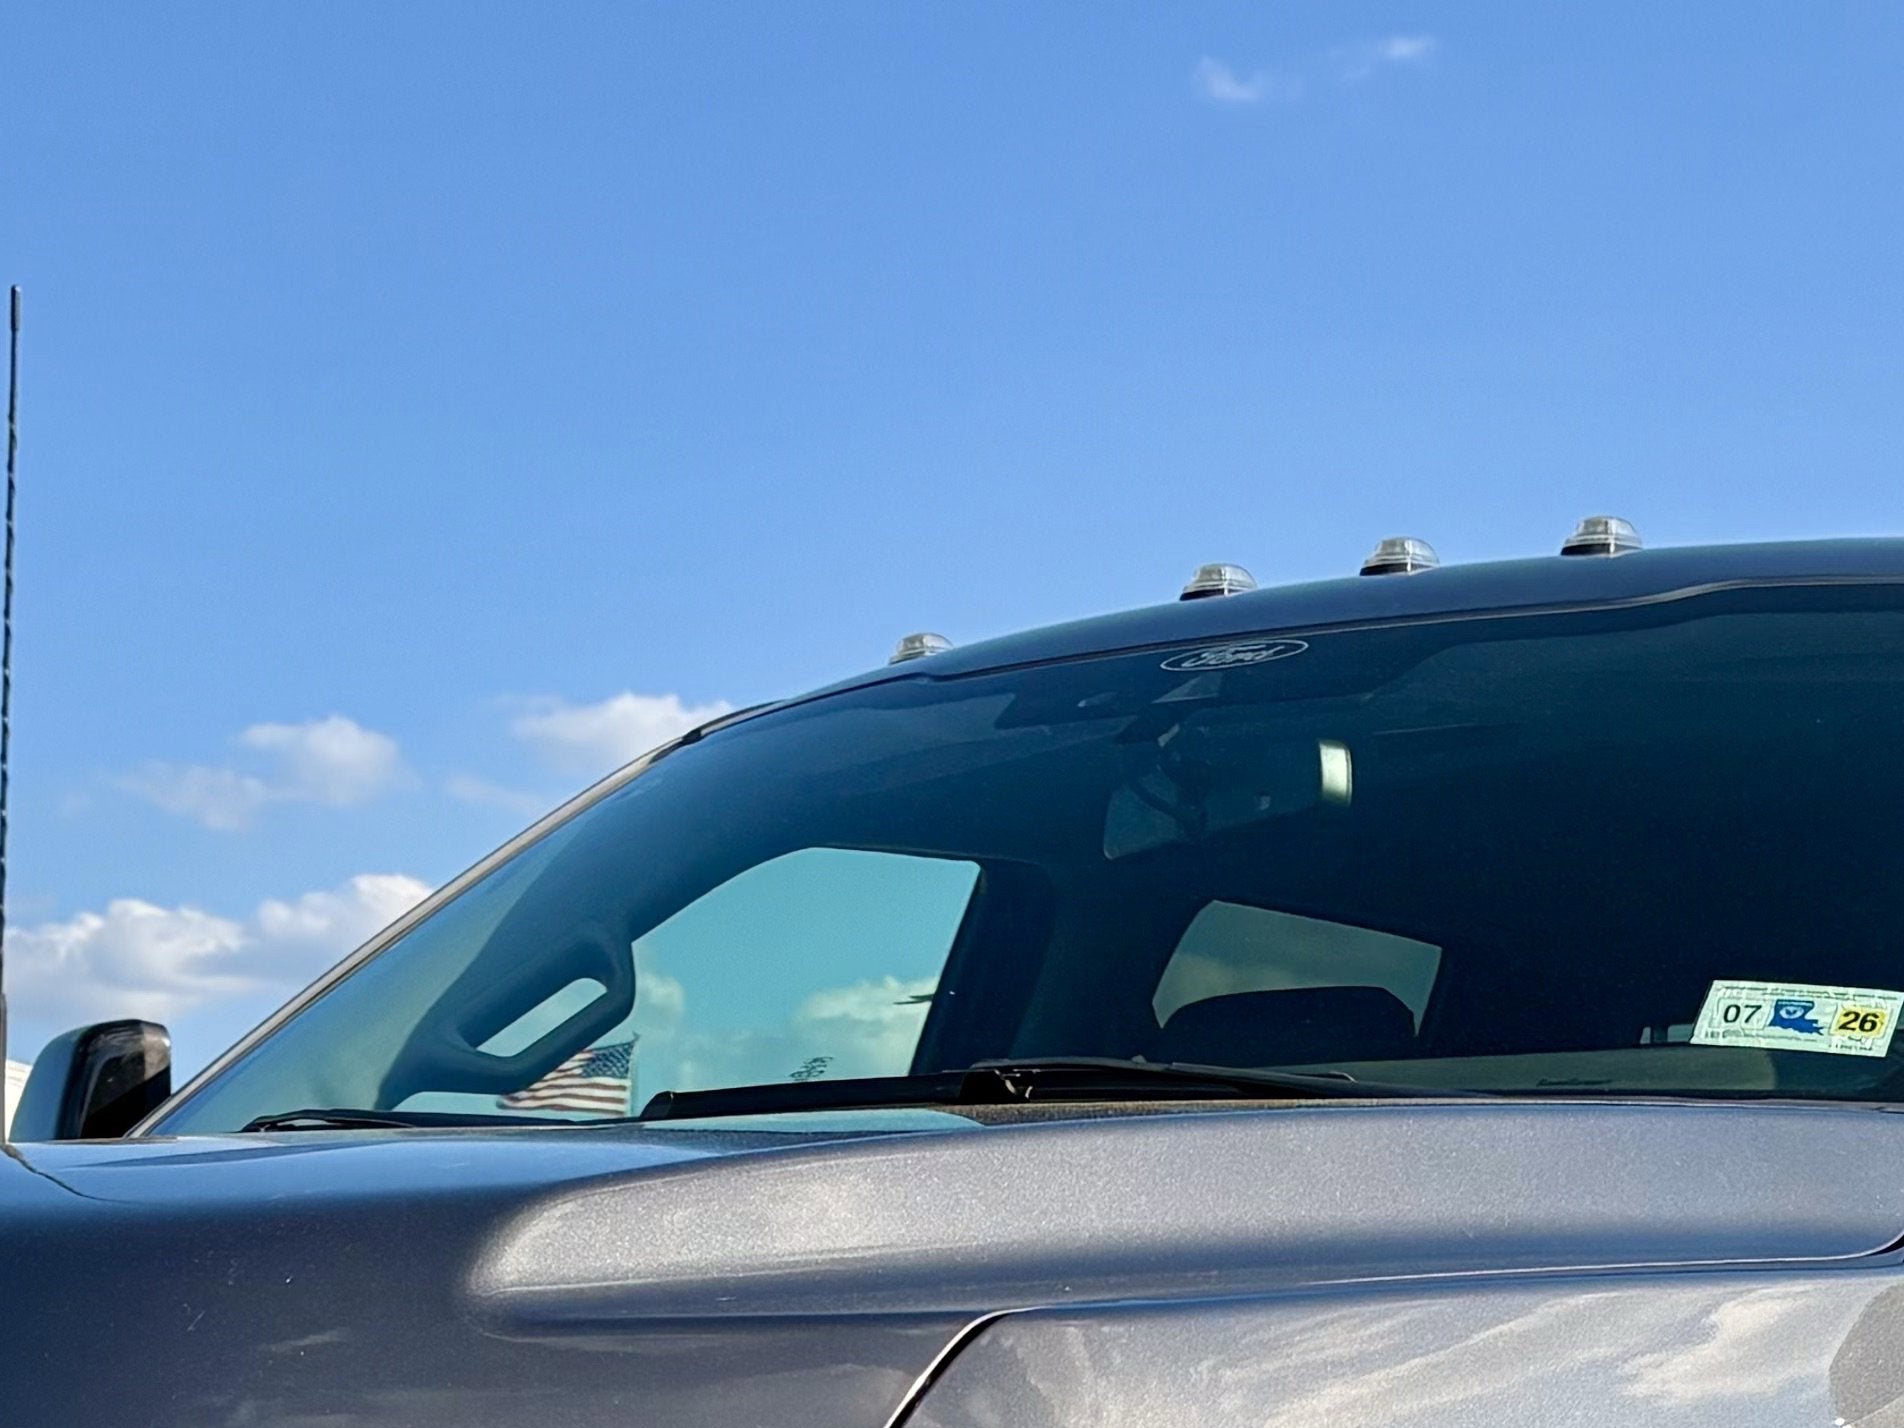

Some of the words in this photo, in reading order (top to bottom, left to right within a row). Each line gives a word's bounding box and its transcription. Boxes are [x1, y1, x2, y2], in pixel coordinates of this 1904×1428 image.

[1180, 643, 1286, 668] Ford
[1722, 1003, 1763, 1024] 07
[1837, 1010, 1881, 1033] 26
